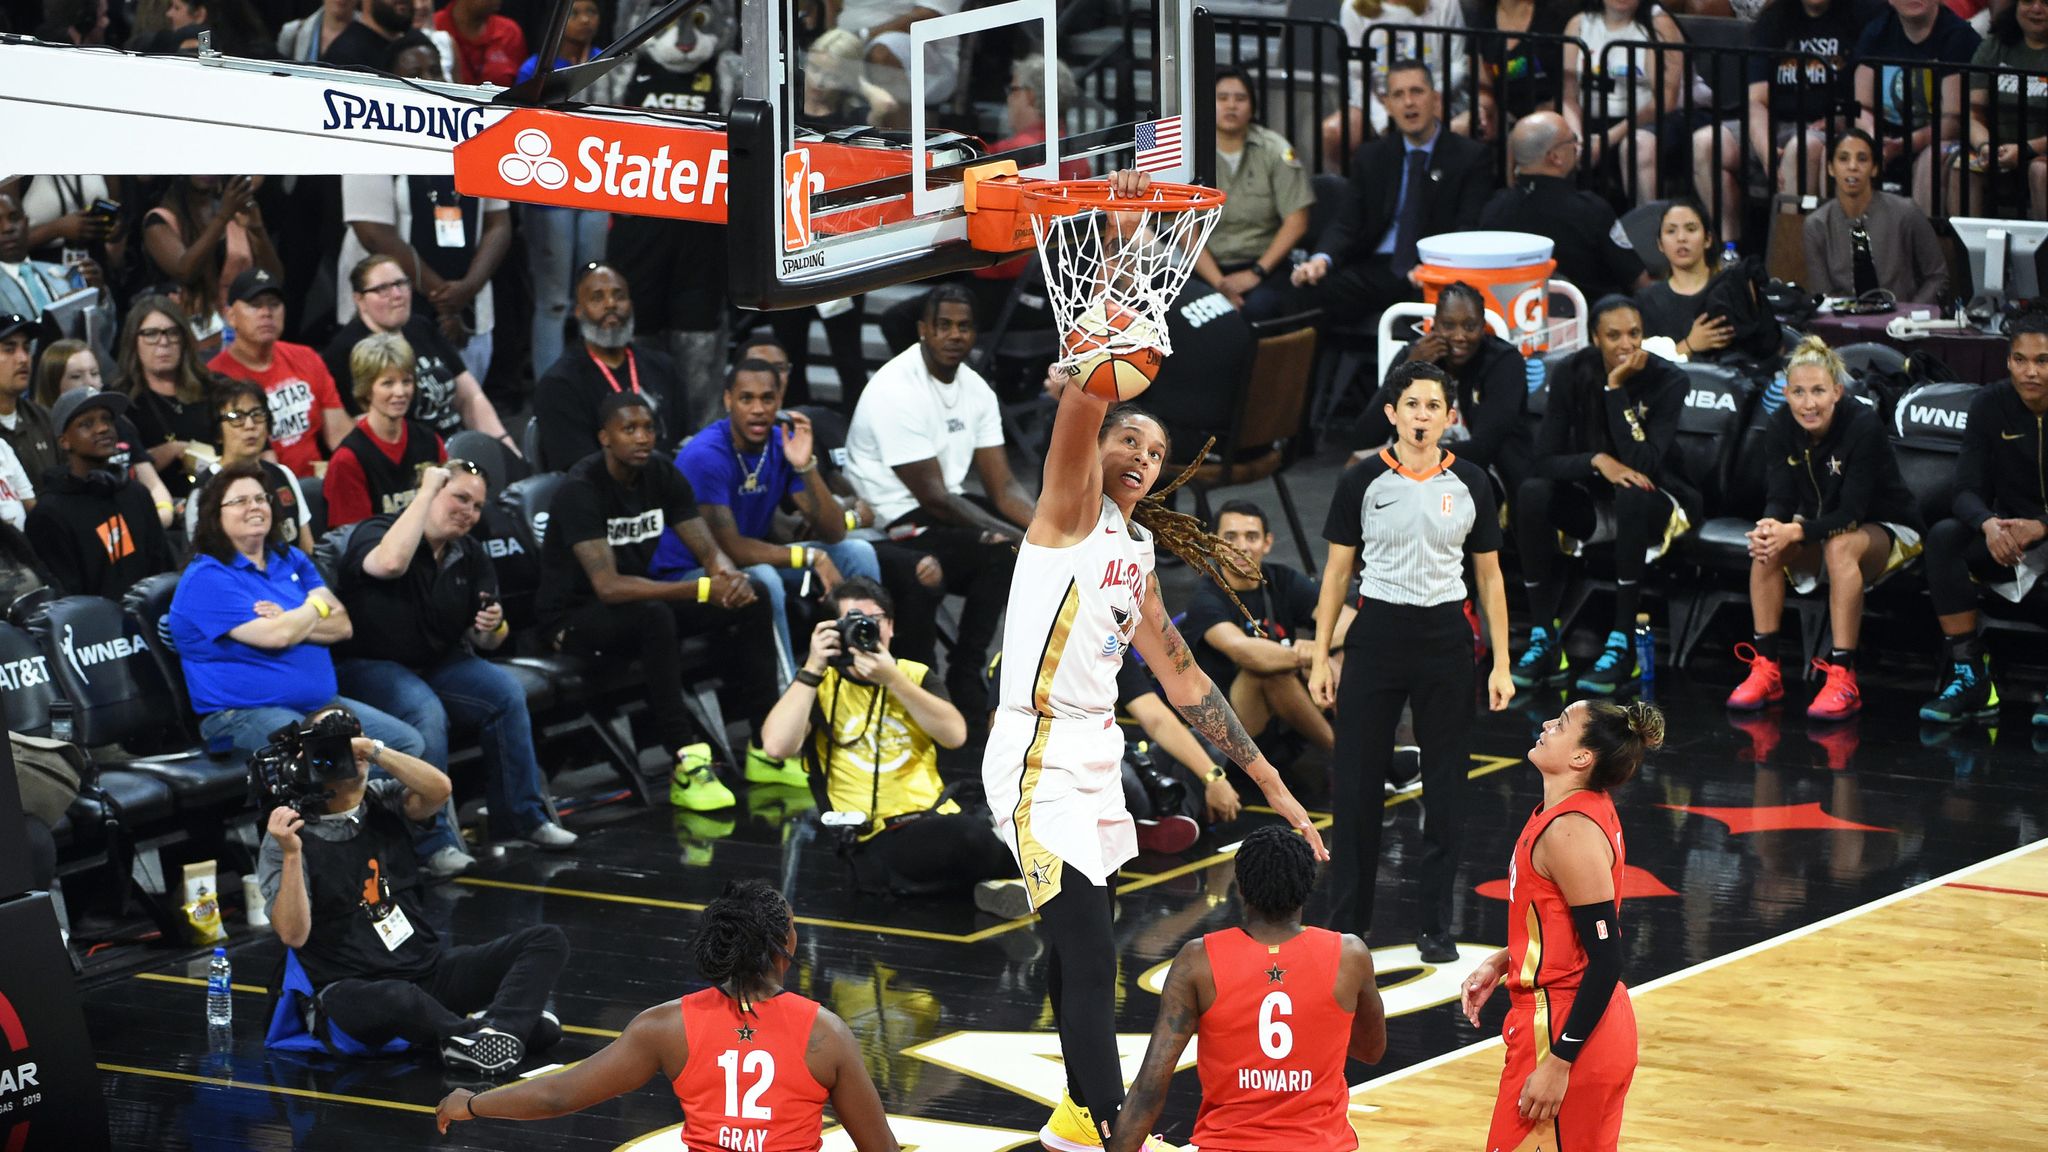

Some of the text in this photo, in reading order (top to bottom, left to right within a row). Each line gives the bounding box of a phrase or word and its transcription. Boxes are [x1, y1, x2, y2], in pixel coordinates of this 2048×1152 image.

[323, 89, 485, 143] SPALDING
[642, 92, 706, 112] ACES
[782, 251, 825, 276] SPALDING
[1514, 287, 1542, 332] G
[1683, 389, 1737, 412] NBA
[76, 634, 149, 667] WNBA
[0, 655, 50, 691] AT&T
[1258, 990, 1294, 1060] 6
[0, 1062, 40, 1097] AR
[717, 1049, 775, 1121] 12
[1238, 1068, 1313, 1092] HOWARD
[22, 1092, 41, 1107] 2019
[718, 1126, 769, 1152] GRAY
